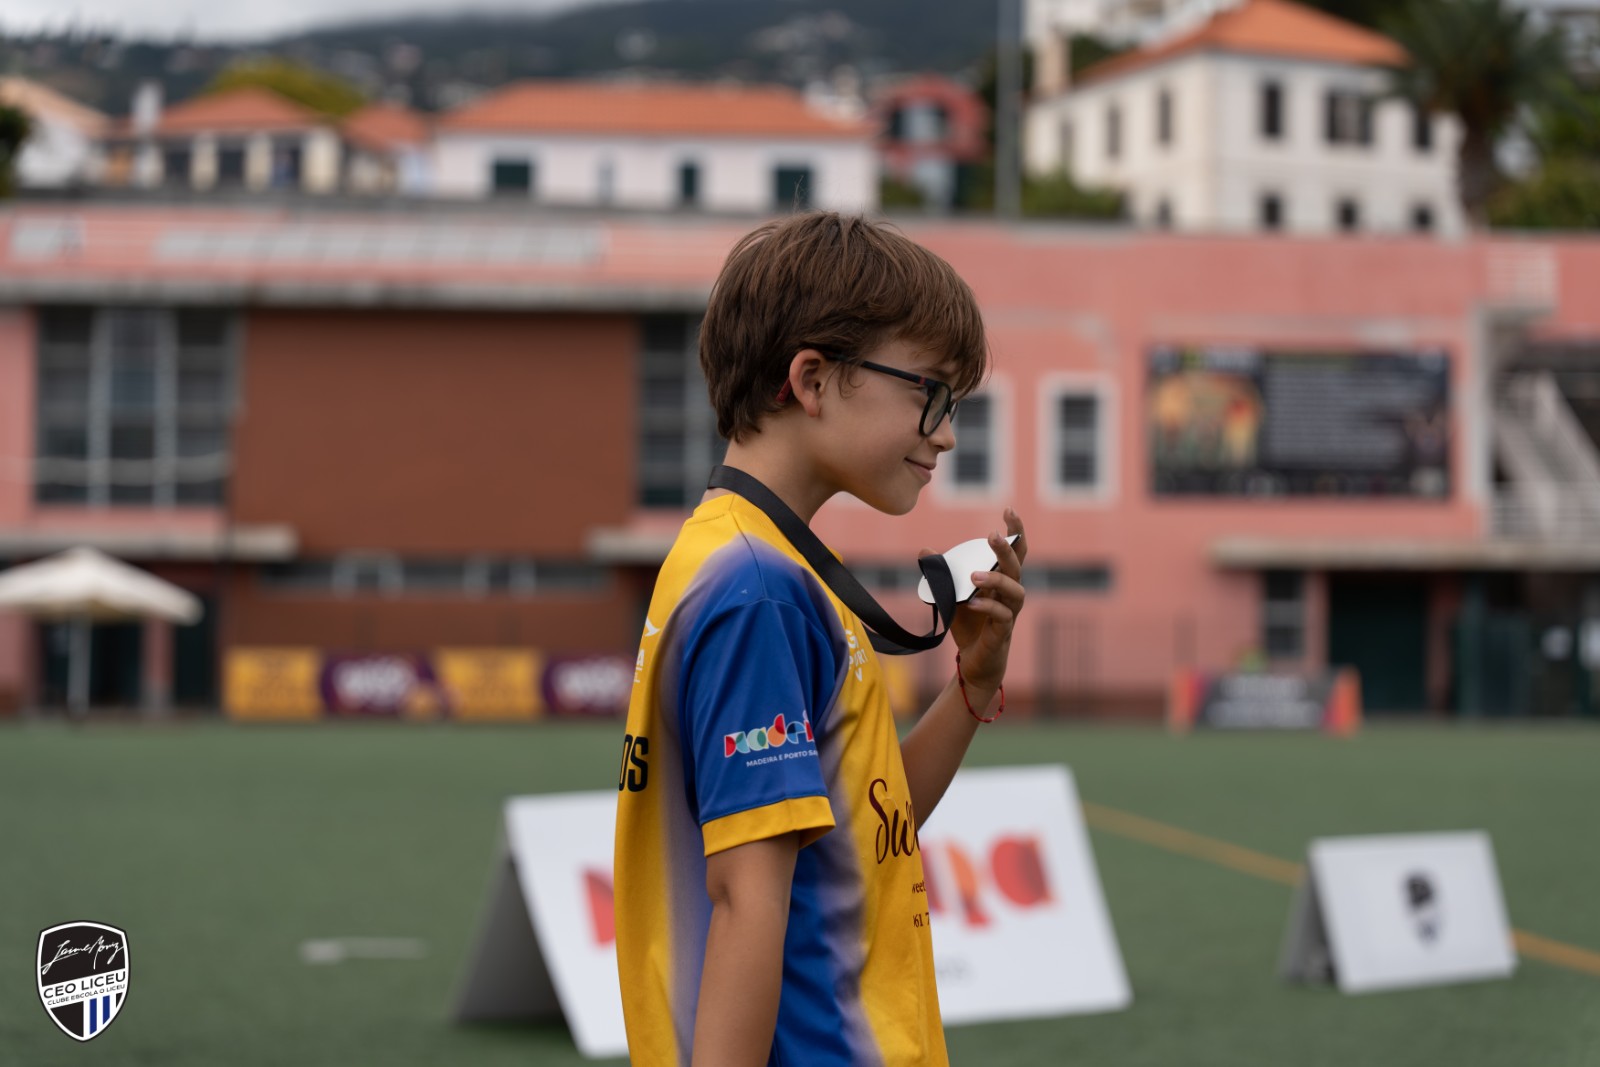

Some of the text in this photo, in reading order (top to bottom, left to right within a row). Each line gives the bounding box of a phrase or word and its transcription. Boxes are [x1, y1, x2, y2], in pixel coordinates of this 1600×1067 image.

[746, 756, 778, 767] MADEIRA
[779, 753, 783, 761] E
[784, 750, 808, 759] PORTO
